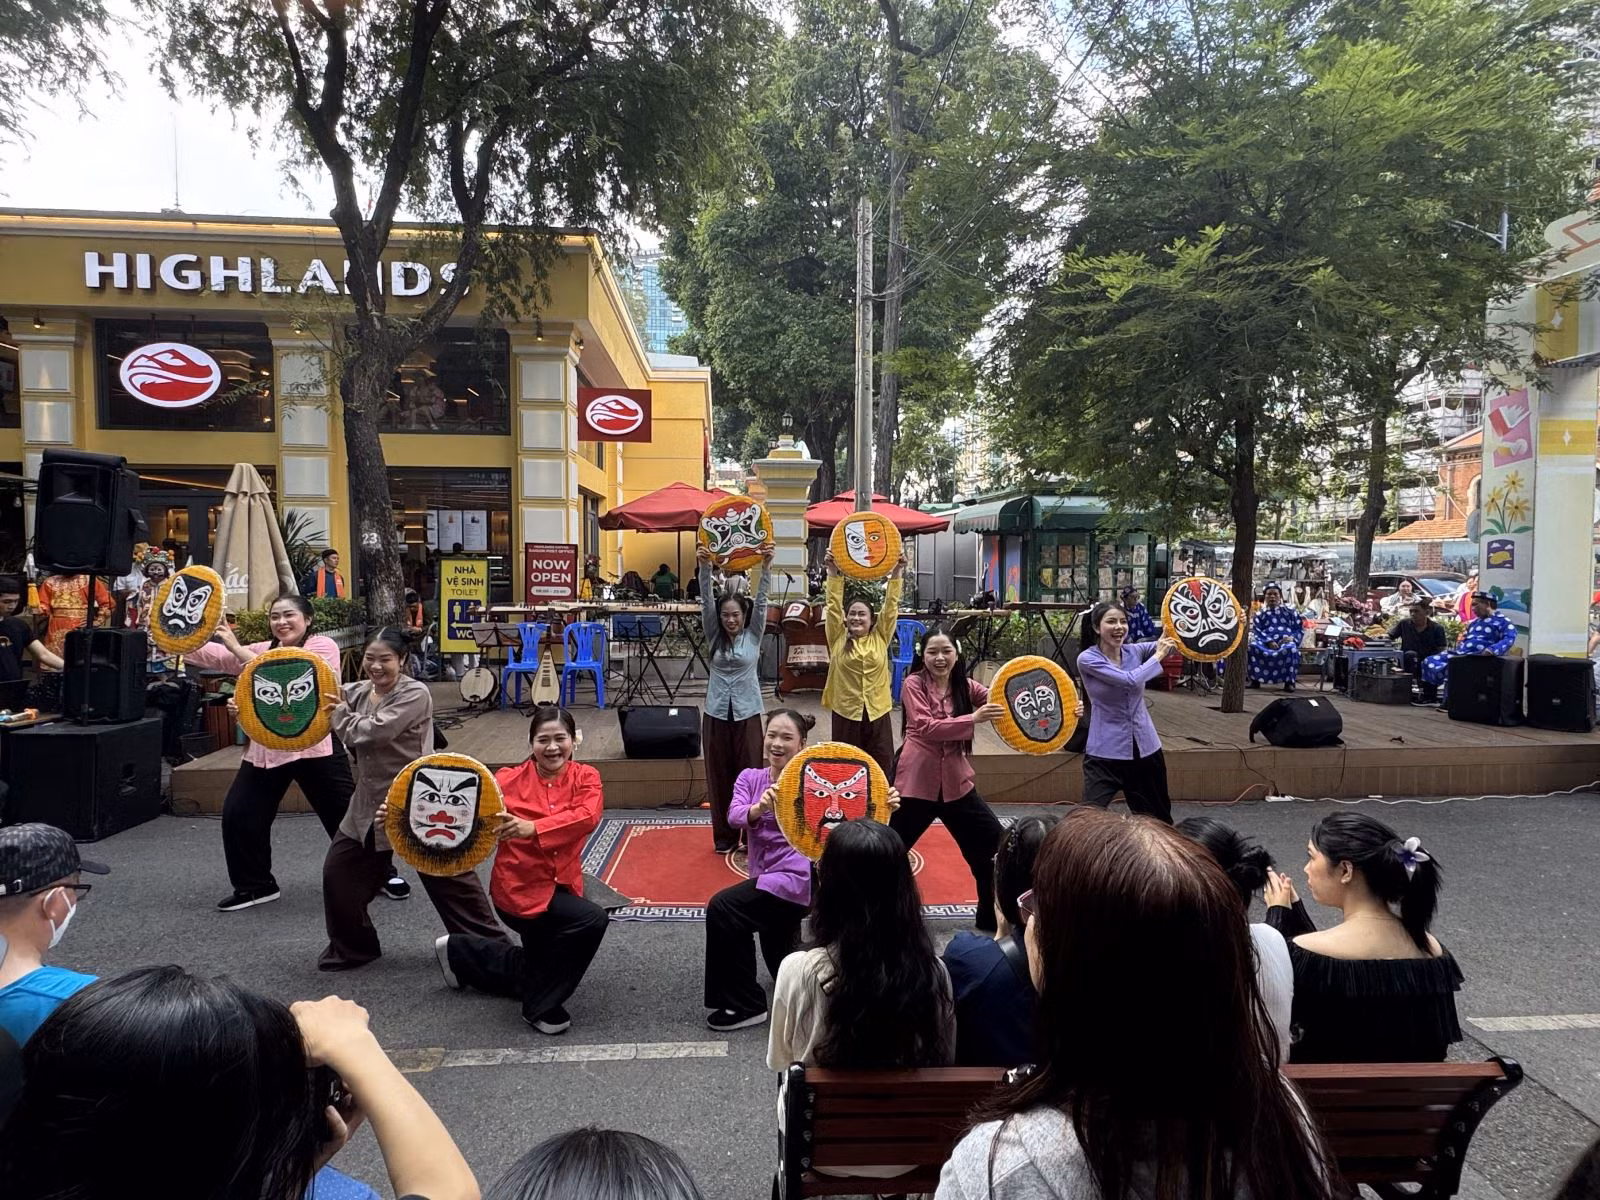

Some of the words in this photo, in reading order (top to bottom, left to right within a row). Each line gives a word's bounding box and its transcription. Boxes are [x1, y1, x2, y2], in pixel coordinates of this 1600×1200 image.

[362, 533, 378, 545] 23
[454, 564, 476, 574] NHÀ
[532, 559, 570, 570] NOW
[446, 575, 459, 587] VỆ
[461, 577, 484, 586] SINH
[530, 572, 571, 583] OPEN
[451, 588, 478, 596] TOILET
[455, 629, 473, 639] WC
